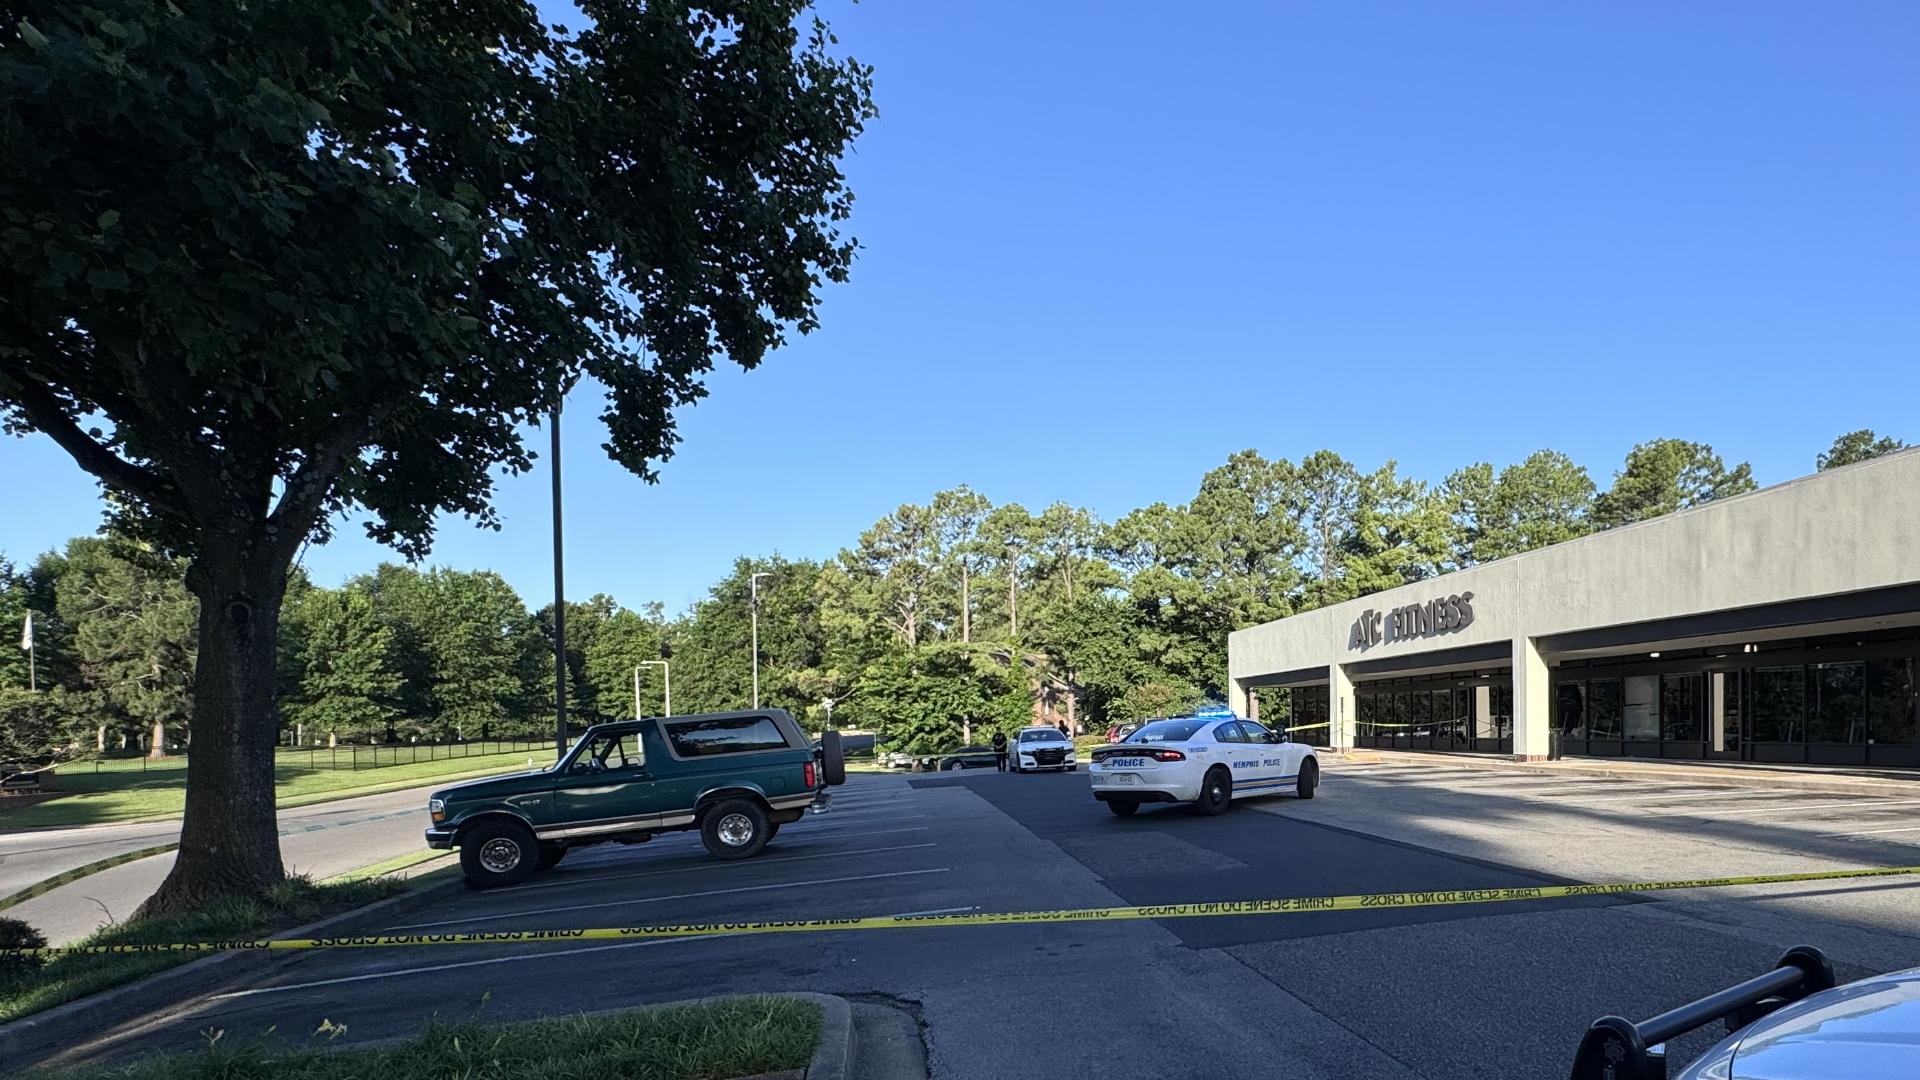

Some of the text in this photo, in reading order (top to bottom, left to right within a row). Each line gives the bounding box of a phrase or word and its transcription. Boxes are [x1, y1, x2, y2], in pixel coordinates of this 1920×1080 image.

[1348, 591, 1474, 652] ATC FITNESS
[1112, 758, 1144, 767] POLICE
[1233, 758, 1280, 769] MEMPHIS POLICE
